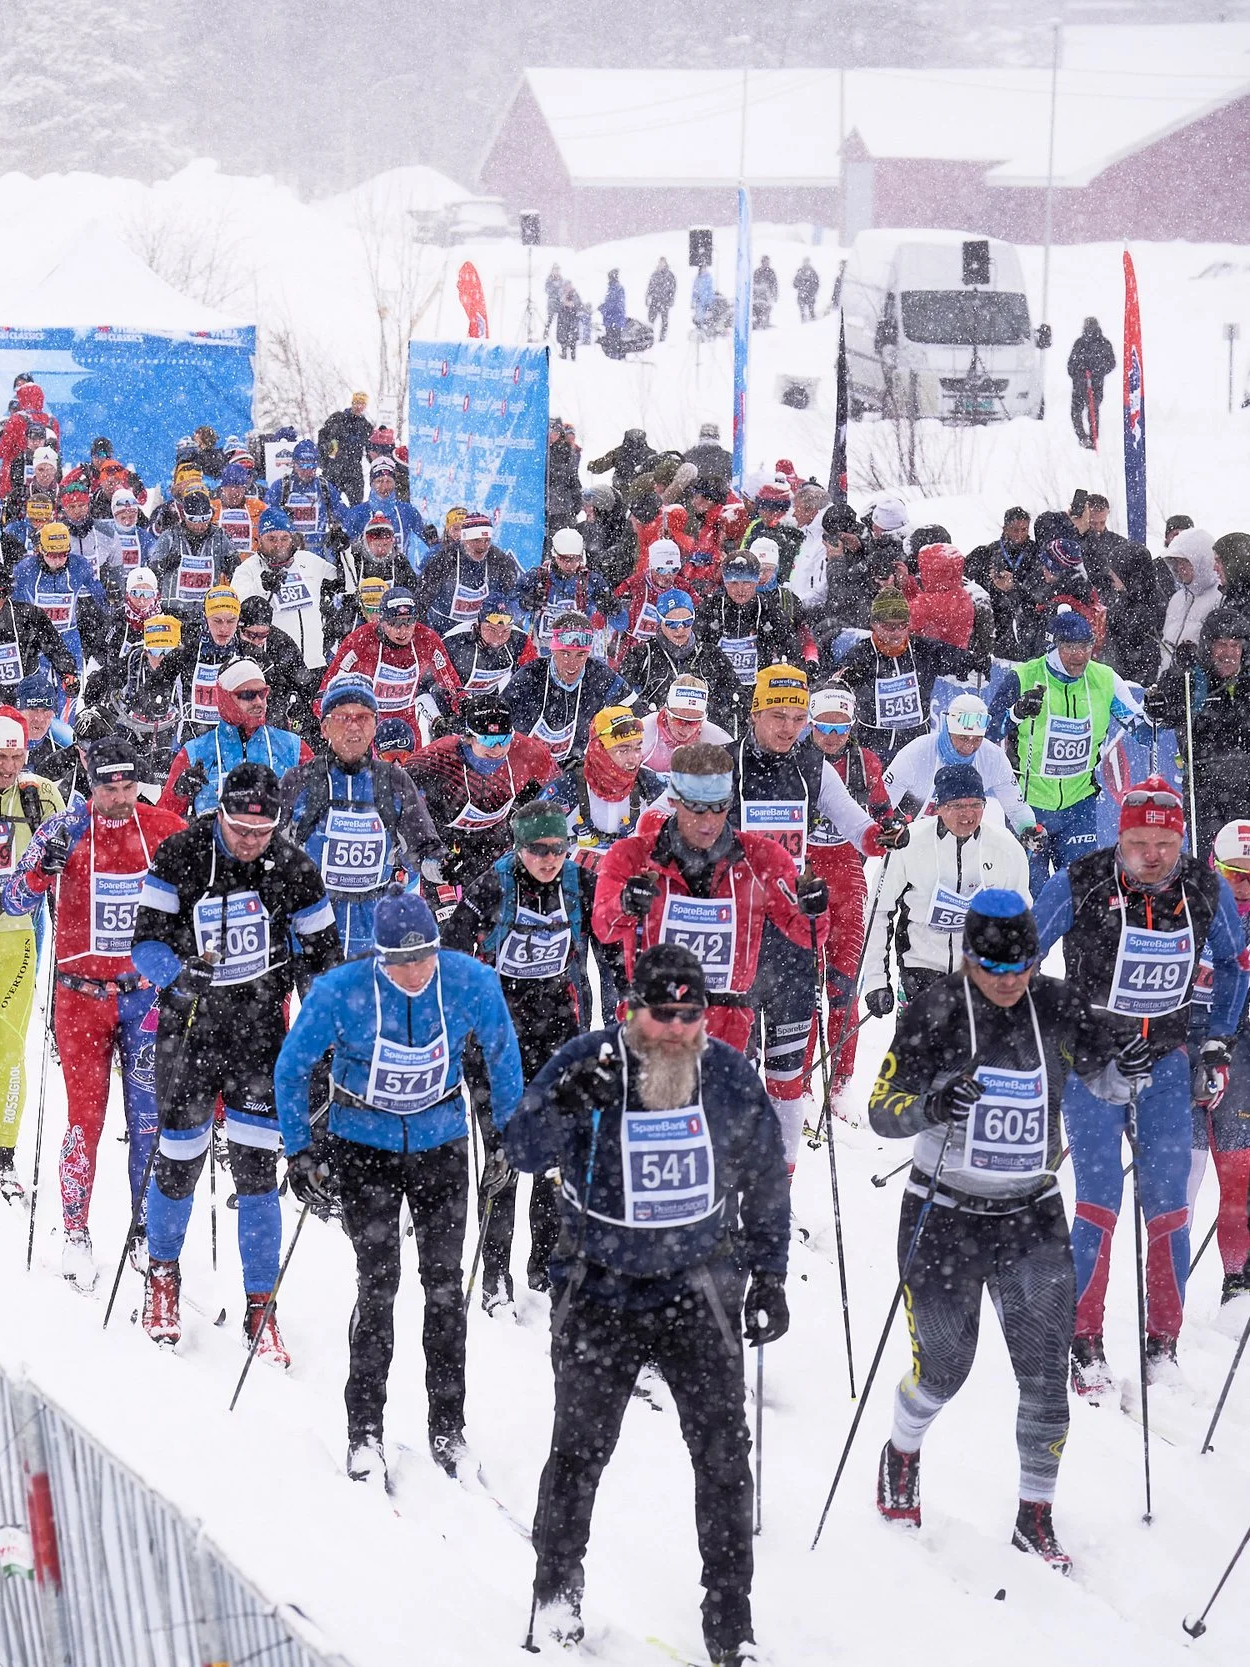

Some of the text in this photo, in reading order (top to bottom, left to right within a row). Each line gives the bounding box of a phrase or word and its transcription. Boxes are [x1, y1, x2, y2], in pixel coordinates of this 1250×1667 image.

[281, 587, 304, 602] 587
[885, 695, 914, 716] 543
[1053, 740, 1087, 759] 660
[750, 807, 790, 818] SpareBank
[334, 818, 371, 829] SpareBank
[1066, 833, 1097, 845] ATEX
[334, 842, 376, 867] 565
[99, 879, 138, 892] SpareBank
[672, 903, 718, 917] SpareBank
[938, 910, 966, 925] 56
[673, 932, 724, 962] 542
[1129, 935, 1177, 950] SpareBank
[1, 938, 31, 1009] OVERTOPPEN
[1128, 963, 1180, 989] 449
[777, 1023, 811, 1035] SpareBan
[383, 1047, 431, 1061] SpareBank
[384, 1070, 434, 1093] 571
[982, 1074, 1036, 1092] SpareBank
[5, 1063, 22, 1125] ROSSIGNOL
[631, 1118, 687, 1134] SpareBank
[984, 1108, 1040, 1143] 605
[641, 1151, 697, 1189] 541
